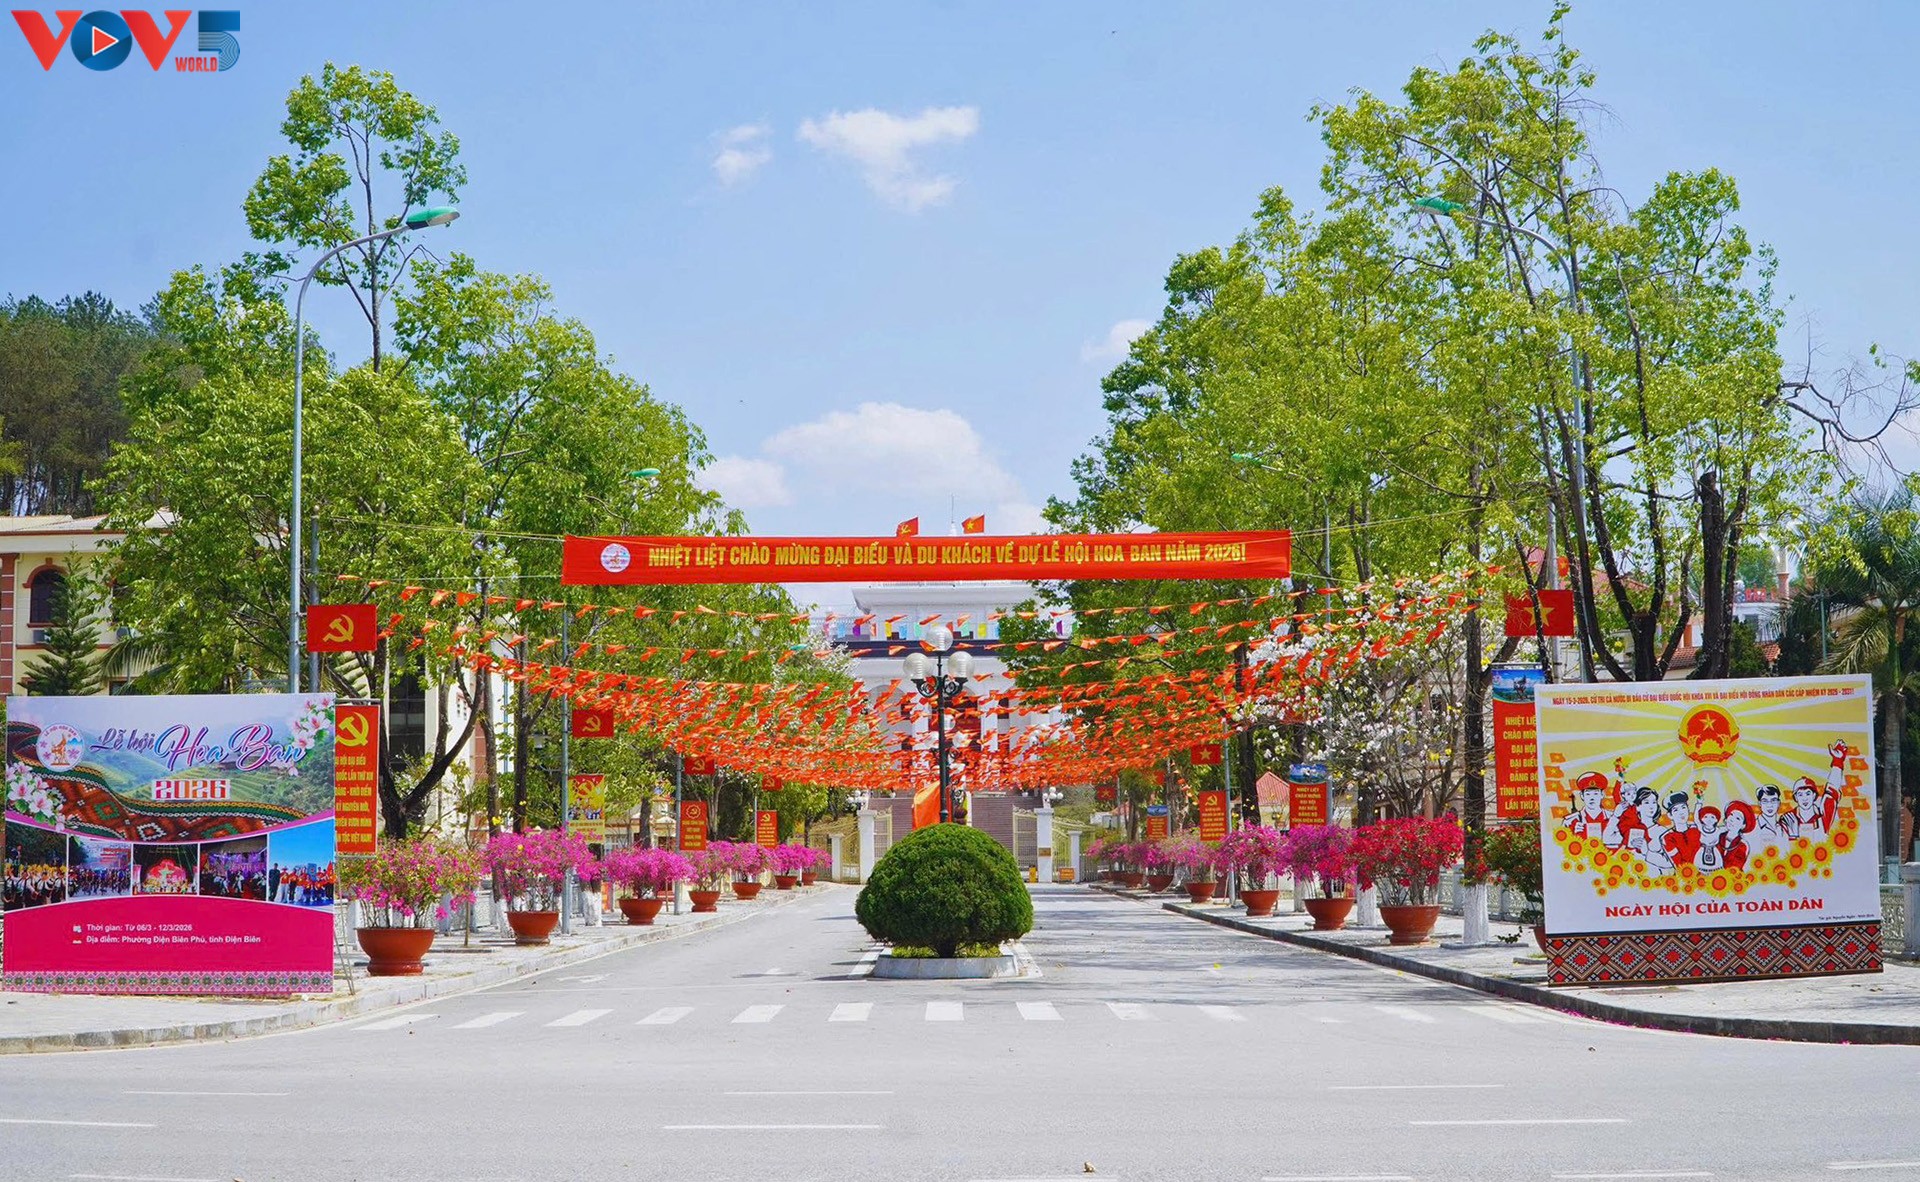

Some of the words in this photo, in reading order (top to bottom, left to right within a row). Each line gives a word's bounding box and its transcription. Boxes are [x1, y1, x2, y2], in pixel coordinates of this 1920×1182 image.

[649, 543, 692, 569] NHIỆT
[696, 543, 726, 568] LIỆT
[730, 542, 770, 565] CHÀO
[775, 543, 820, 565] MỪNG
[824, 546, 849, 567] ĐẠI
[854, 541, 888, 565] BIỂU
[894, 542, 913, 565] VÀ
[917, 546, 937, 564] DU
[942, 542, 991, 564] KHÁCH
[996, 541, 1014, 563] VỀ
[1019, 543, 1041, 565] DỰ
[1043, 540, 1060, 562] LỄ
[1064, 541, 1090, 565] HỘI
[1094, 545, 1124, 562] HOA
[1130, 544, 1161, 561] BAN
[1165, 540, 1200, 561] NĂM
[1205, 543, 1246, 562] 2026!
[1505, 715, 1525, 727] NHIỆT
[1526, 715, 1537, 727] LIỆ
[1503, 729, 1521, 740] CHÀO
[90, 726, 126, 752] Lễ
[127, 729, 156, 752] hội
[154, 724, 228, 771] Hoa
[228, 723, 307, 771] Ban
[1511, 745, 1523, 755] ĐẠI
[1510, 759, 1521, 770] ĐẠI
[1510, 769, 1528, 782] ĐẢNG
[155, 780, 227, 799] 2026
[1605, 903, 1653, 917] NGÀY
[1659, 902, 1690, 917] HỘI
[1696, 900, 1731, 914] CỦA
[1735, 899, 1783, 913] TOÀN
[1788, 897, 1823, 910] DÂN
[87, 923, 104, 931] Thời
[105, 923, 123, 933] gian:
[125, 923, 135, 931] Từ
[136, 923, 152, 931] 06/3
[159, 923, 193, 931] 12/3/2026
[86, 935, 99, 944] Địa
[100, 934, 120, 943] điểm:
[122, 935, 152, 945] Phường
[153, 935, 170, 945] Điện
[172, 935, 189, 943] Biên
[209, 935, 224, 943] tỉnh
[225, 935, 242, 944] Điện
[244, 935, 261, 943] Biên
